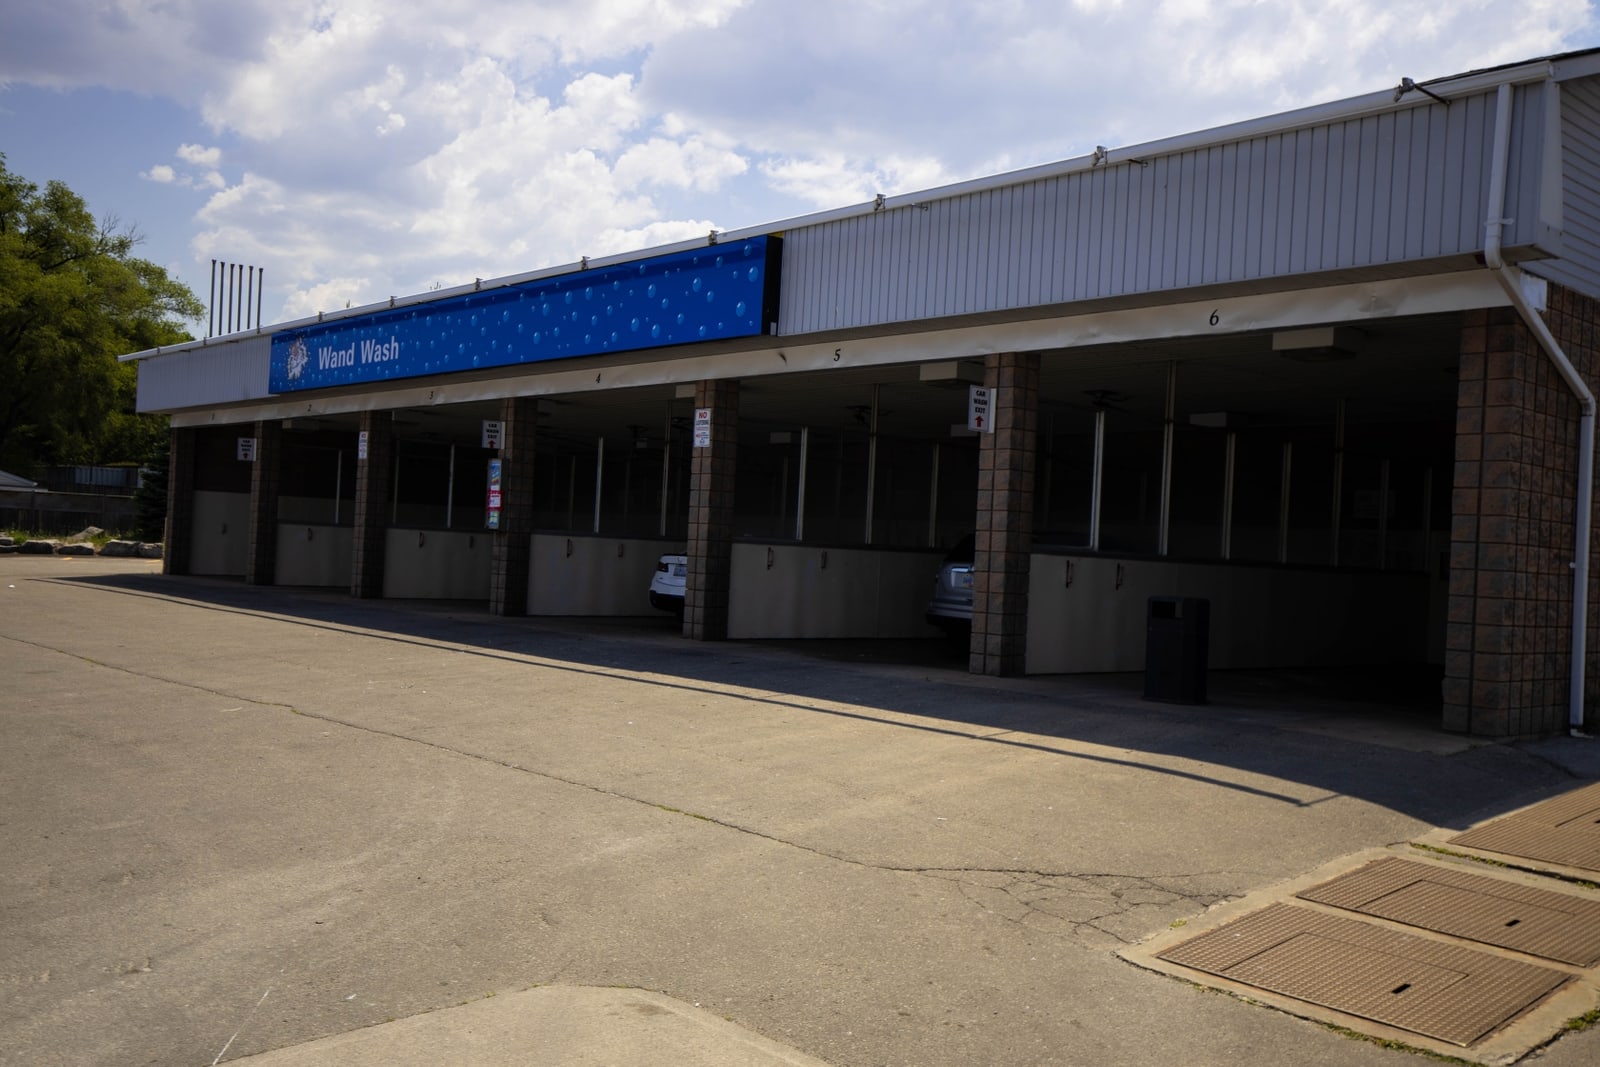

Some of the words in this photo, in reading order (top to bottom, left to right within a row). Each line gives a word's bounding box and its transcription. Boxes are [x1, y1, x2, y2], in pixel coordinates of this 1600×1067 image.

[1209, 308, 1219, 326] 6
[318, 342, 355, 370] Wand
[361, 335, 399, 364] Wash
[833, 348, 841, 362] 5
[596, 373, 601, 384] 4
[428, 390, 434, 400] 3
[973, 398, 988, 406] WASH
[698, 411, 708, 419] NO
[974, 406, 986, 414] EXIT
